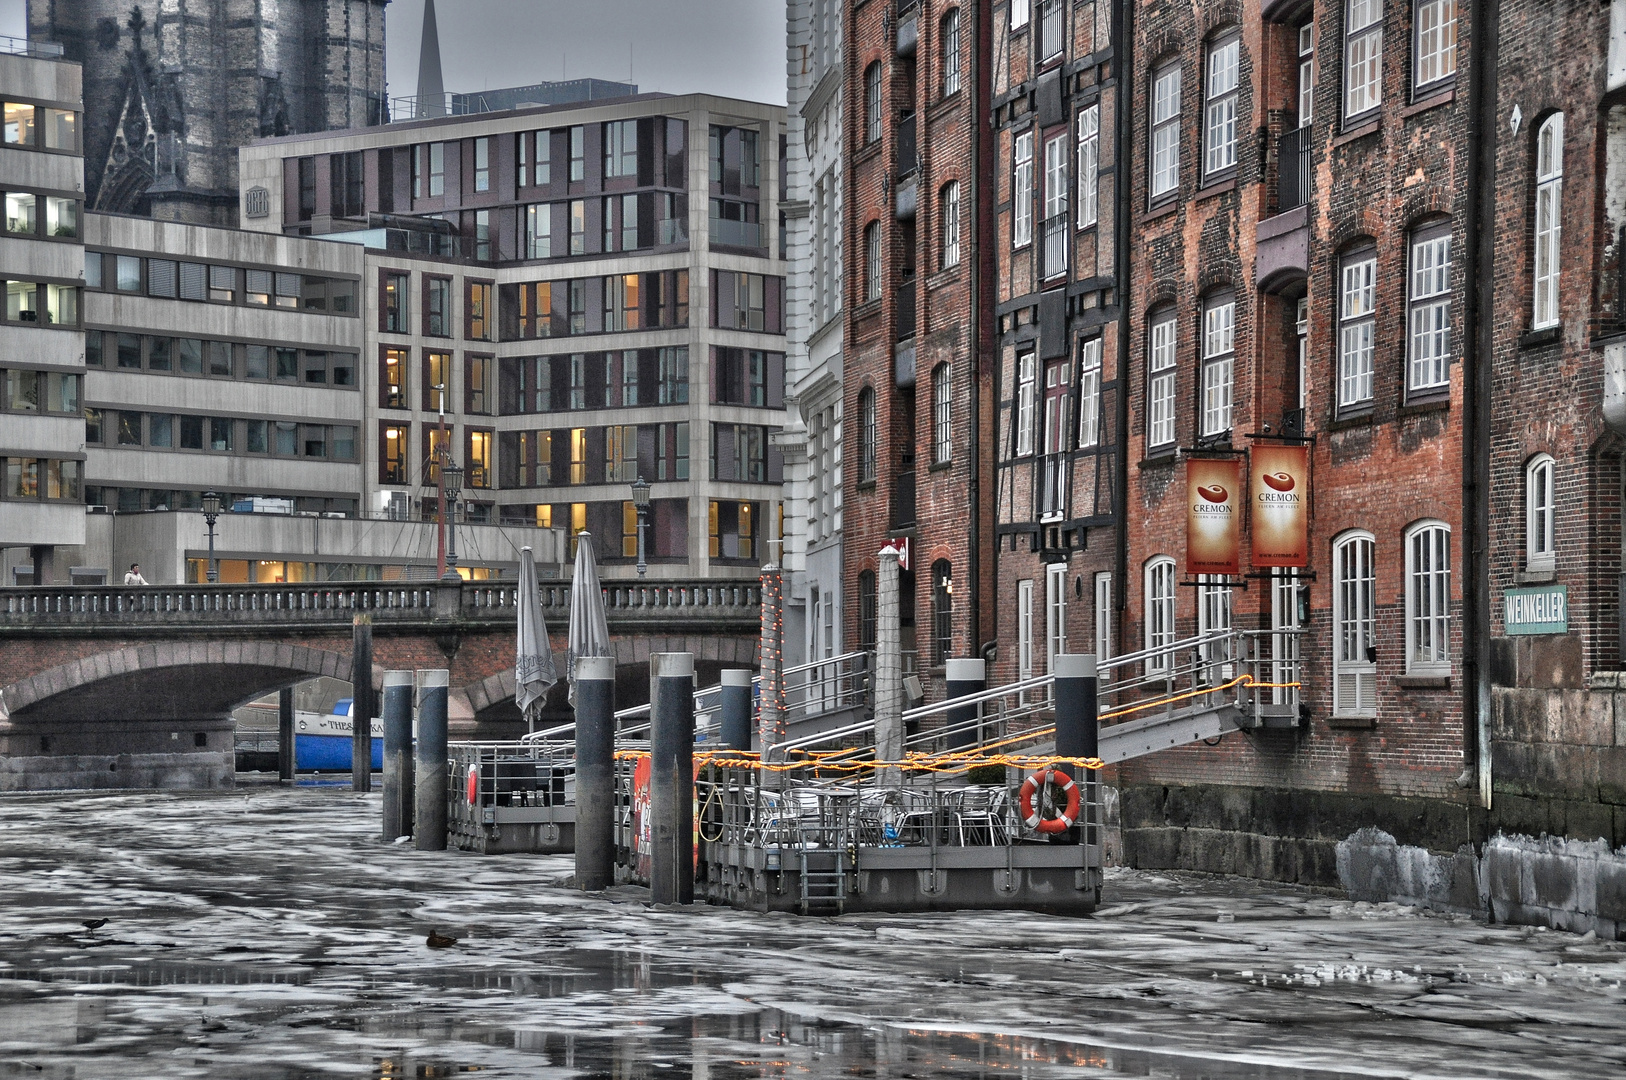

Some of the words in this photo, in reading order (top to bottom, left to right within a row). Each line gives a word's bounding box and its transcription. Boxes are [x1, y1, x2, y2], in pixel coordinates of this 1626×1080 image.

[1258, 493, 1300, 502] CREMON
[1193, 504, 1233, 513] CREMON
[1506, 592, 1565, 624] WEINKELLER
